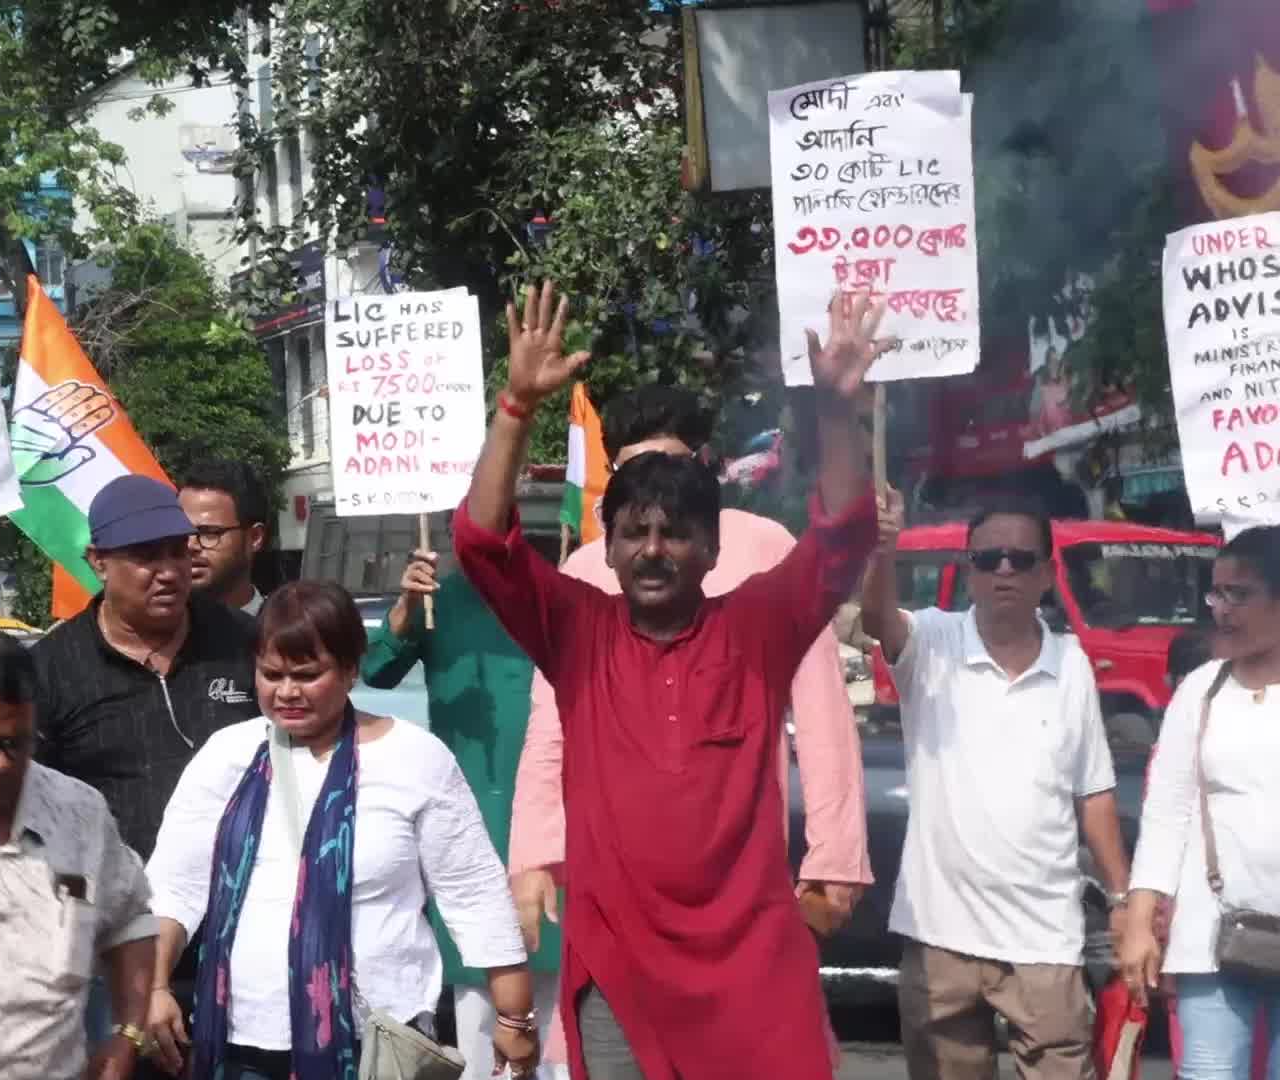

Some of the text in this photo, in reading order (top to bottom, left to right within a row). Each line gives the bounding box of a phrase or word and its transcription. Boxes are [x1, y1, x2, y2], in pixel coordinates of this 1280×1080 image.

[796, 120, 888, 151] আদানি
[899, 158, 941, 176] LIC
[1192, 226, 1271, 256] UNDER
[334, 300, 443, 323] LIC HAS
[336, 321, 463, 348] SUFFERED
[1232, 327, 1249, 339] IS
[346, 350, 410, 374] LOSS
[1200, 387, 1233, 402] AND
[352, 401, 445, 427] DUE TO
[344, 454, 419, 477] ADANI
